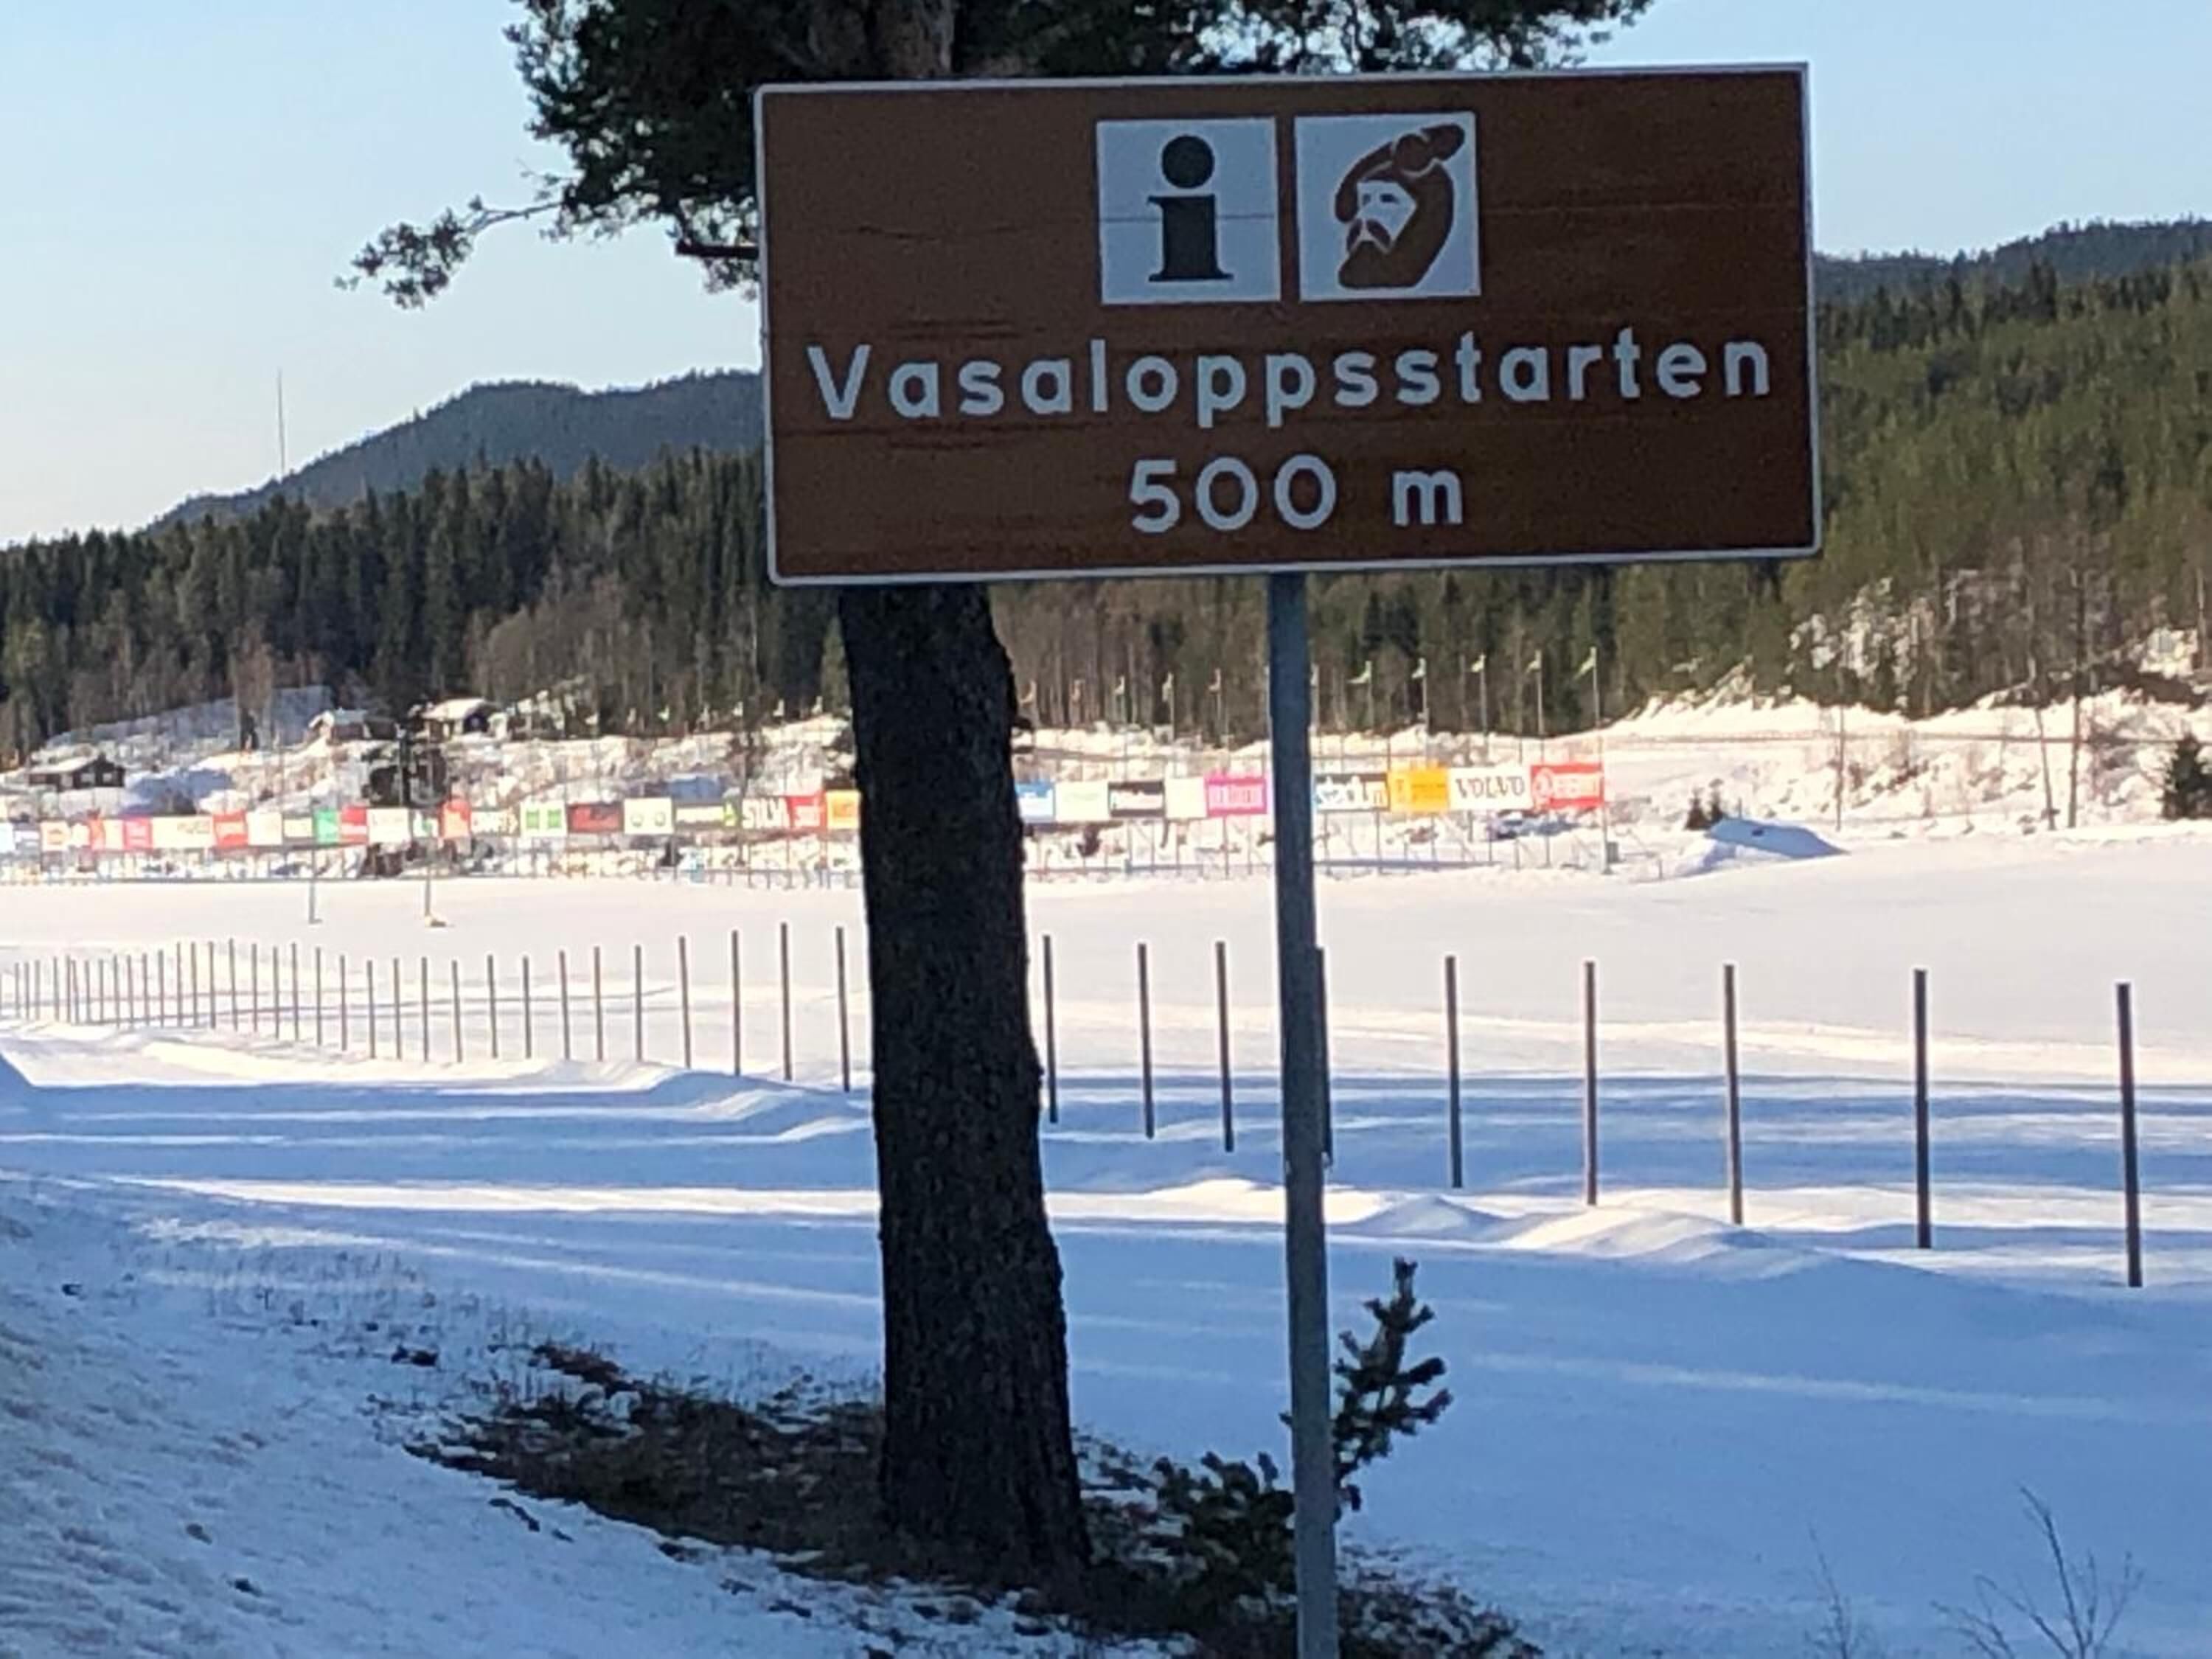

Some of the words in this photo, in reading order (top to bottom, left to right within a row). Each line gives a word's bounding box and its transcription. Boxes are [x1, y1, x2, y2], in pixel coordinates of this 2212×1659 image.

[807, 327, 1770, 428] Vasaloppsstarten
[1130, 453, 1337, 533] 500
[1393, 470, 1463, 526] m
[1455, 775, 1526, 799] VOLVO
